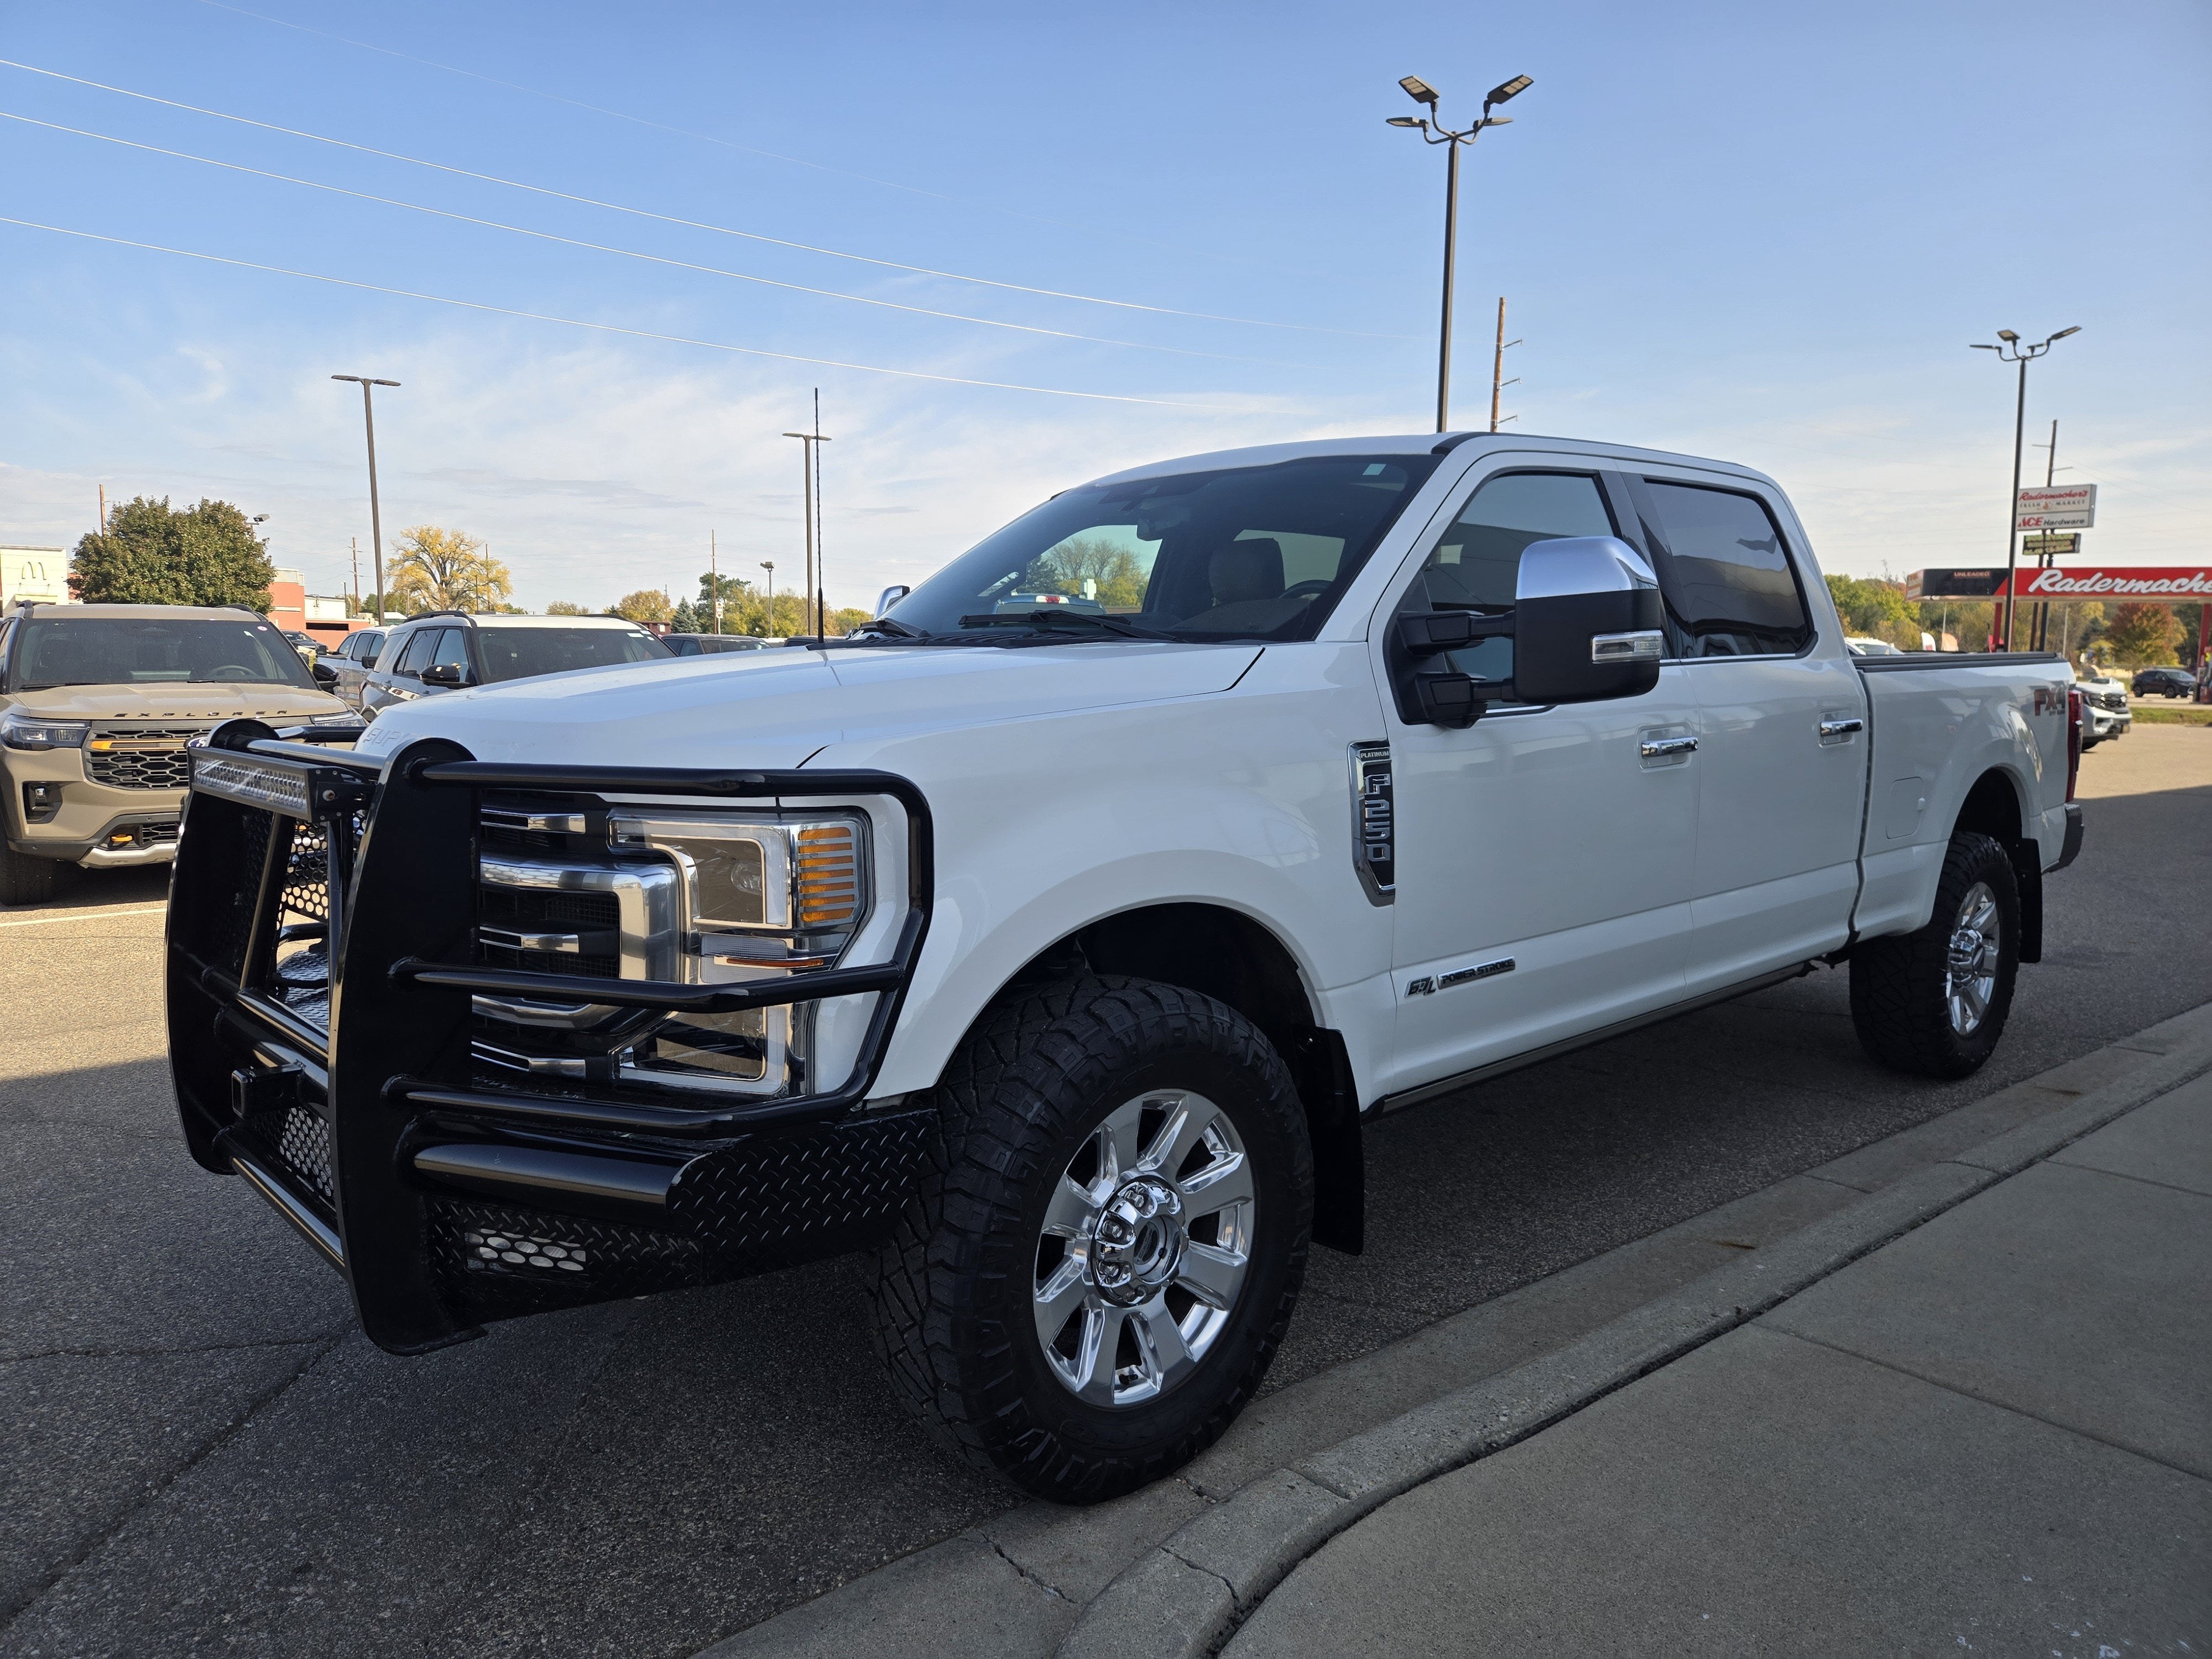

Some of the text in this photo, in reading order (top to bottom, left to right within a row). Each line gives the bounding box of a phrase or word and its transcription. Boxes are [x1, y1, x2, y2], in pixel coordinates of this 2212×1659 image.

[2017, 516, 2044, 528] ACE
[1360, 750, 1389, 759] PLATINUM
[1441, 969, 1476, 984] POWER
[1477, 958, 1514, 975] STROKE
